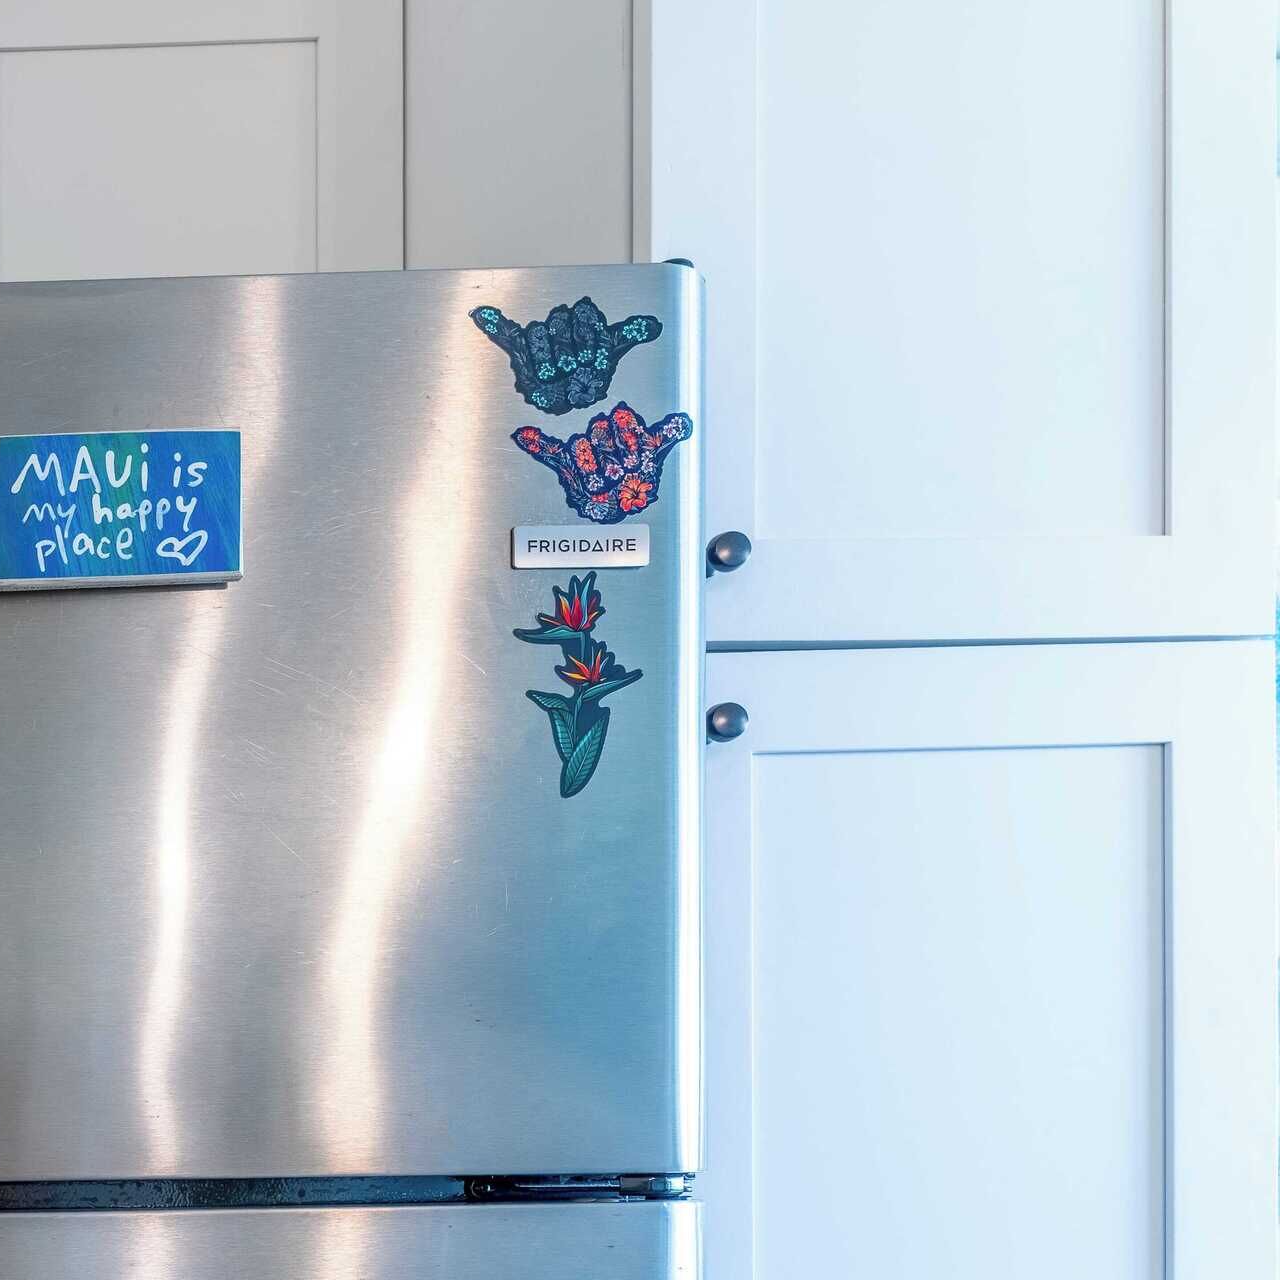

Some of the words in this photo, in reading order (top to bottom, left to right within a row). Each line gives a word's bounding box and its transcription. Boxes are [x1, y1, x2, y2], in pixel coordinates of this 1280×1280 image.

[173, 452, 208, 488] is
[22, 502, 77, 538] my
[91, 493, 198, 533] happy
[35, 524, 133, 573] place
[527, 538, 637, 553] FRIGIDAIRE
